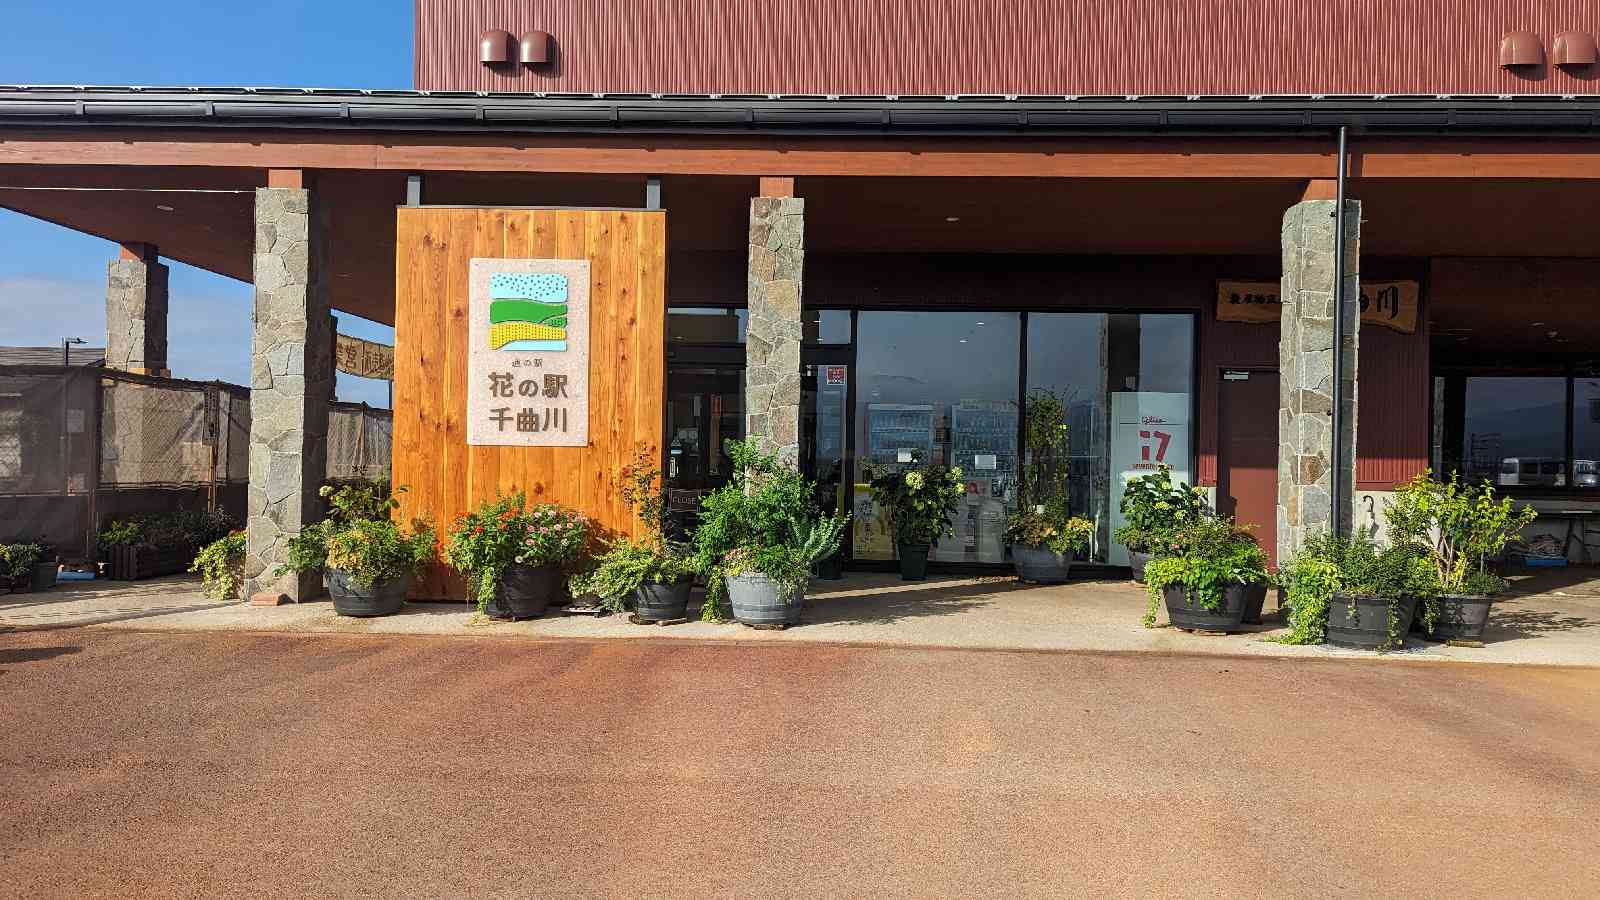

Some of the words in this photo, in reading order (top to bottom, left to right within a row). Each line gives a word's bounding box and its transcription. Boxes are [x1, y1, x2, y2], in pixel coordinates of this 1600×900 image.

[489, 372, 568, 398] 花の駅
[489, 407, 567, 432] 千曲川
